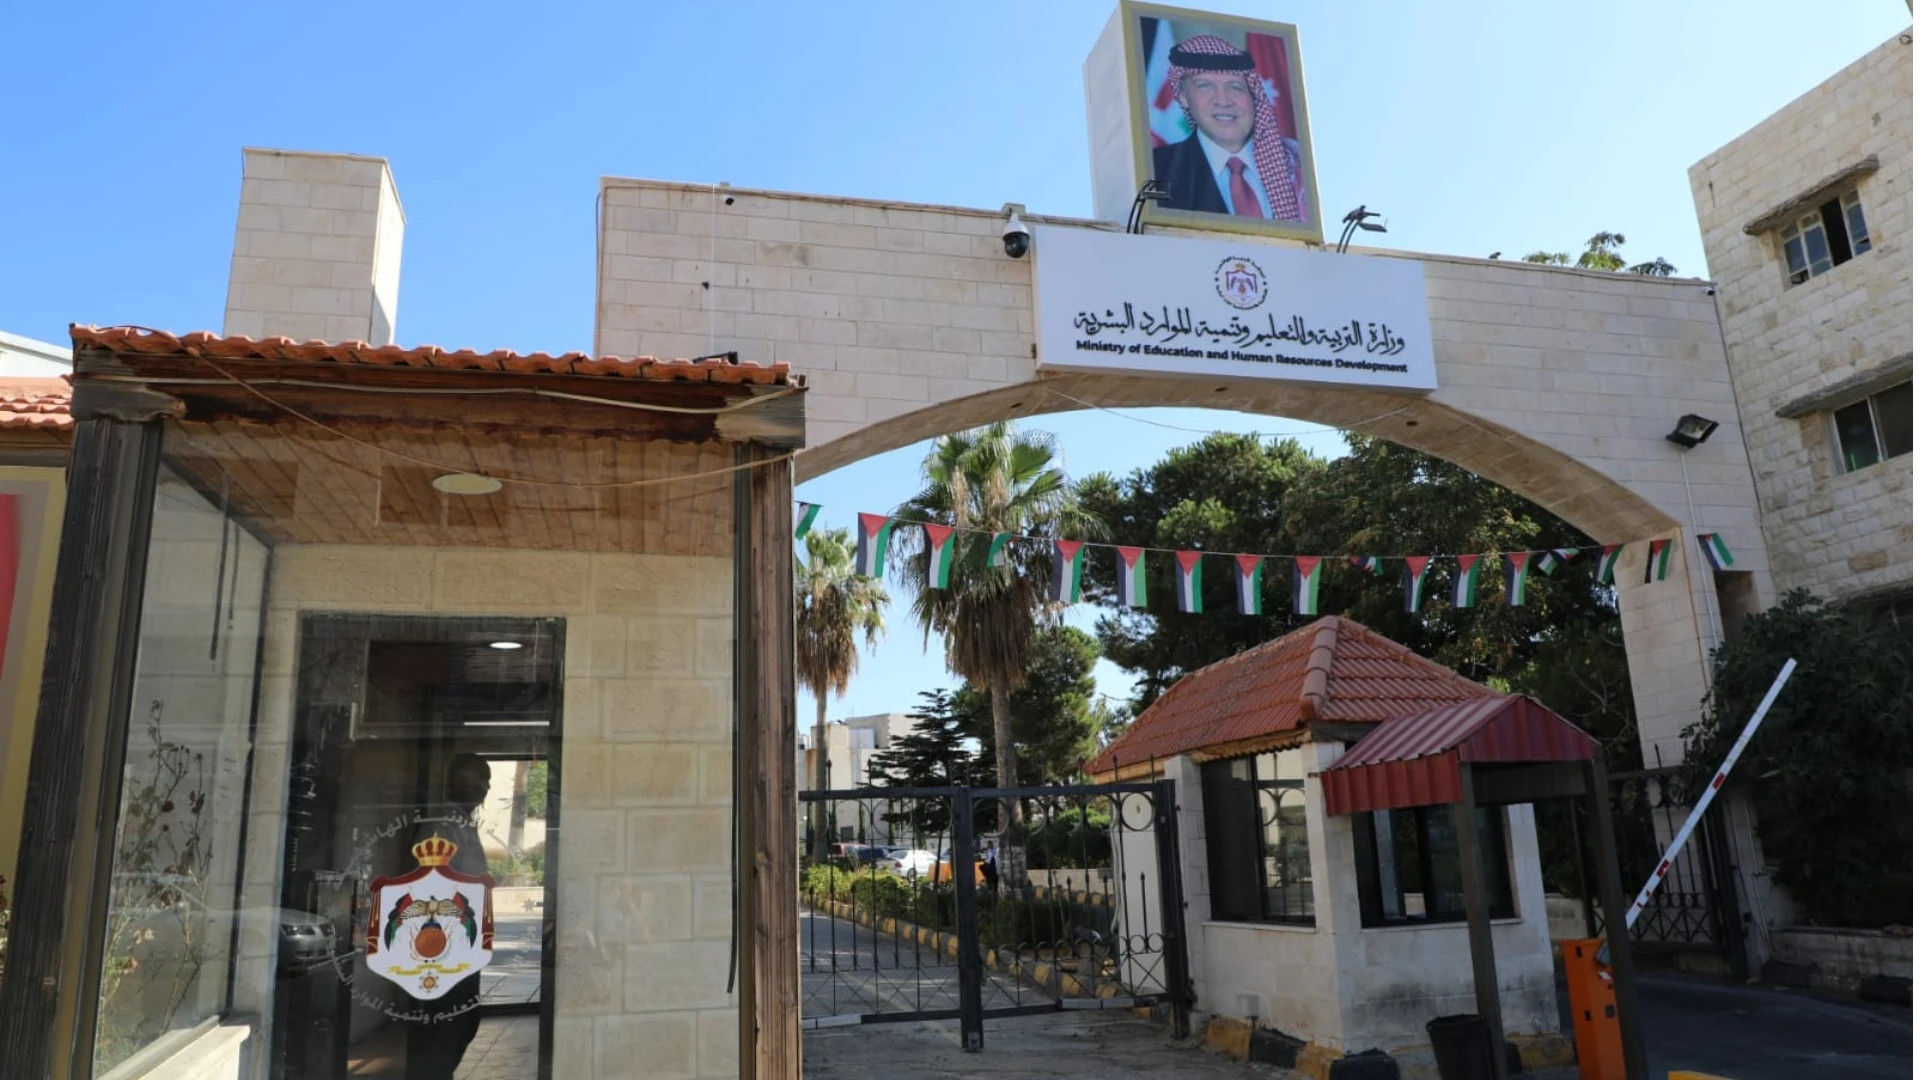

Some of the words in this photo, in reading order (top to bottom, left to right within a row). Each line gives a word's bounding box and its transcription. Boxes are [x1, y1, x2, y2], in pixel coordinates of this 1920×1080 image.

[1073, 301, 1135, 336] البشرية
[1139, 305, 1192, 343] الموارد
[1195, 316, 1250, 345] وتنمية
[1239, 312, 1315, 349] والتعليم
[1314, 319, 1363, 353] التربية
[1367, 323, 1406, 356] وزارة
[1076, 340, 1126, 355] Ministry
[1129, 343, 1141, 354] of
[1144, 345, 1204, 359] Education
[1206, 350, 1229, 360] and
[1231, 351, 1274, 363] Human
[1276, 354, 1333, 367] Resources
[1335, 358, 1409, 374] Development
[383, 1001, 431, 1025] وتنمية
